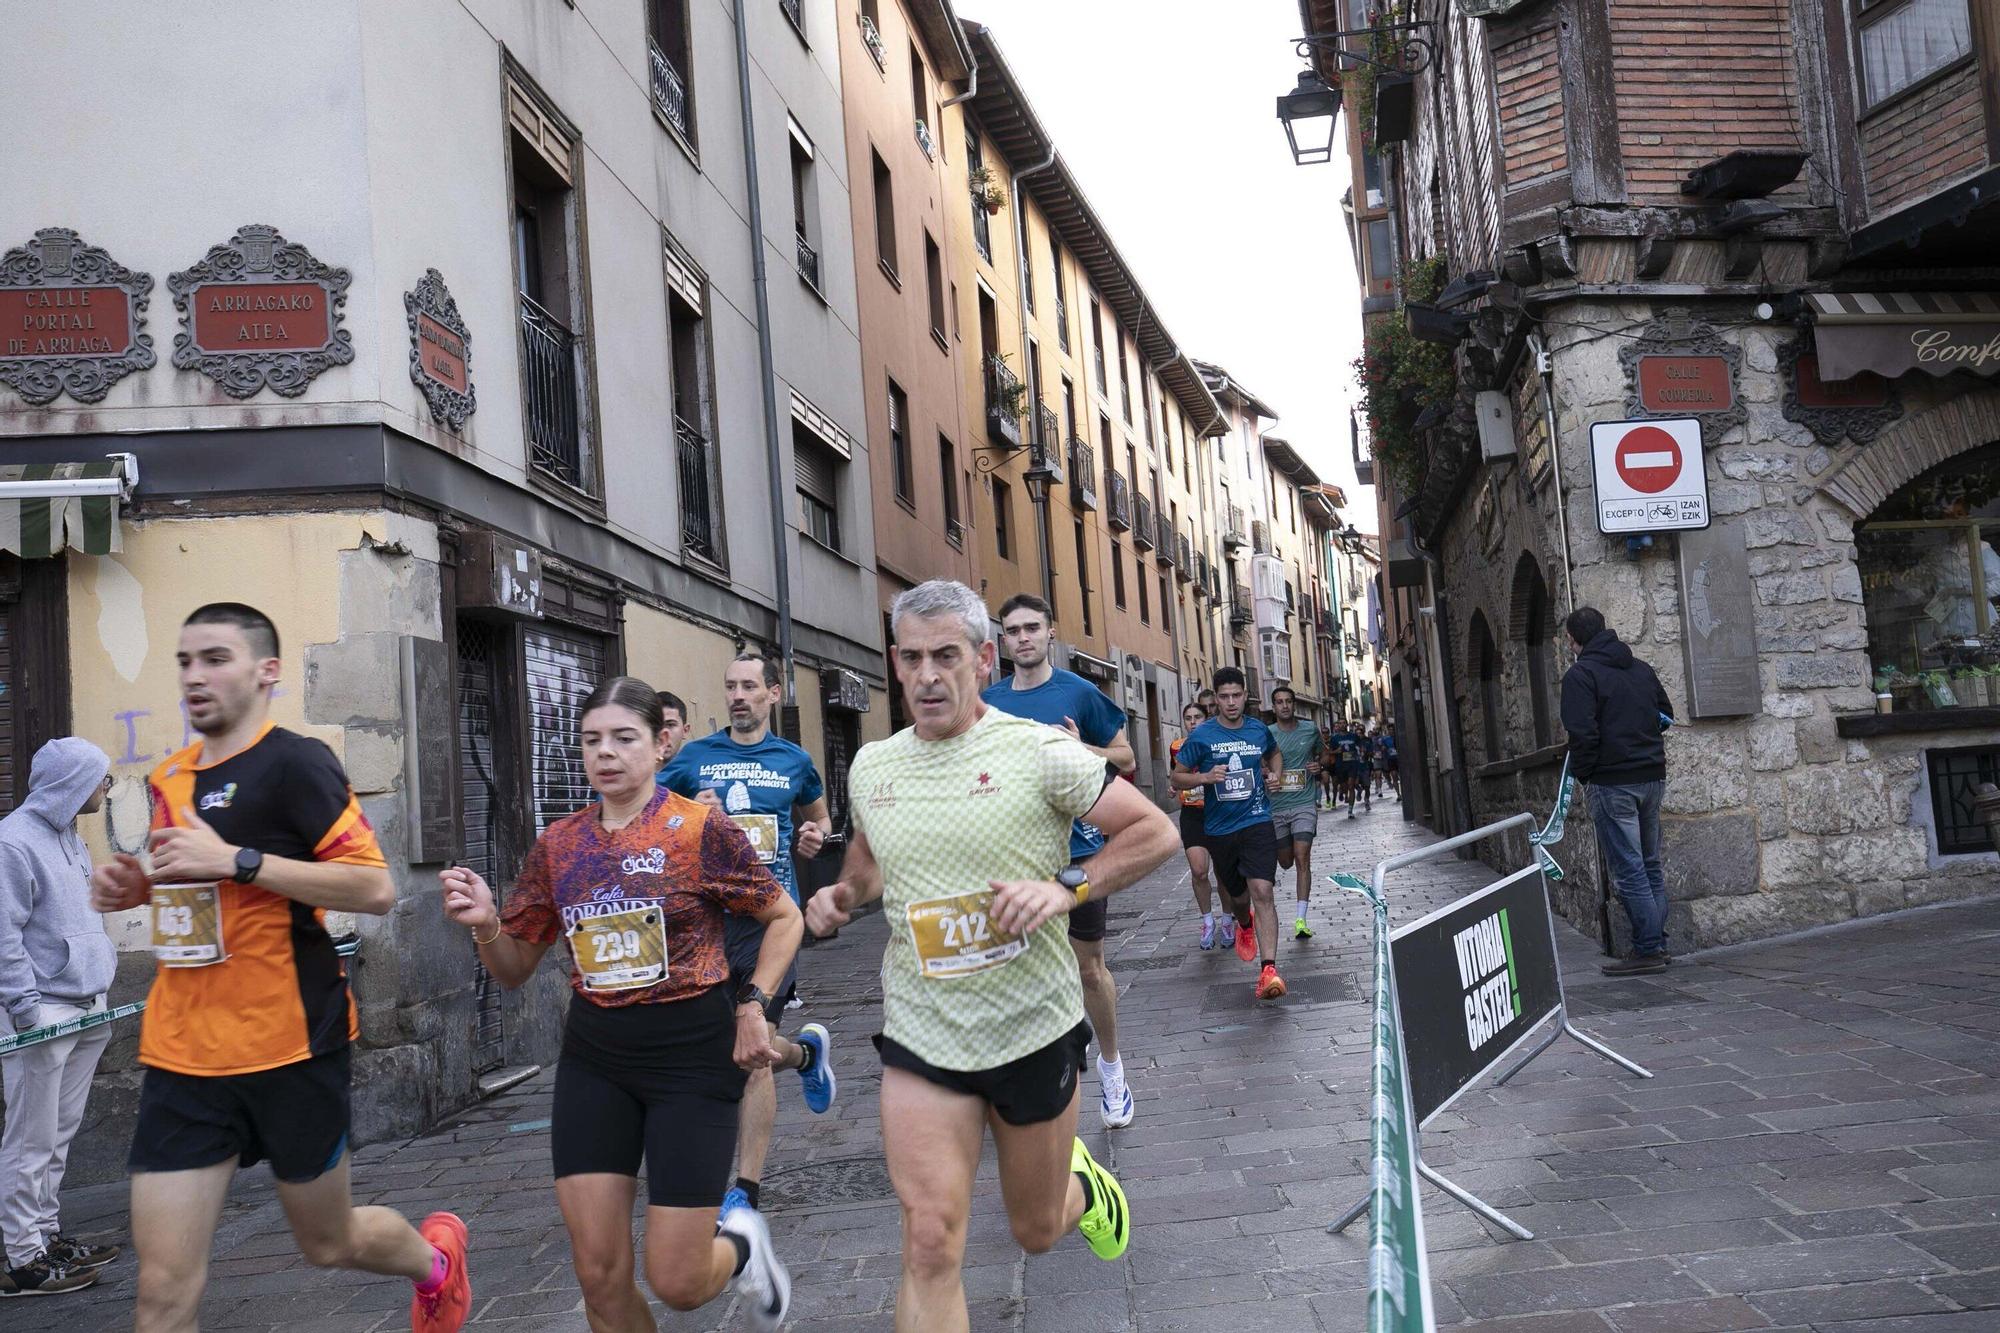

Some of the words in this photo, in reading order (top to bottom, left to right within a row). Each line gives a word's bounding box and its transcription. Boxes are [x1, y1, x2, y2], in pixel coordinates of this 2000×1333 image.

[25, 290, 91, 308] CALLE
[210, 294, 313, 312] ARRIAGAKO
[23, 313, 96, 331] PORTAL
[239, 323, 288, 340] ATEA
[9, 338, 29, 355] DE
[35, 336, 113, 354] ARRIAGA
[1665, 364, 1702, 380] CALLE
[1605, 508, 1645, 519] EXCEPTO
[1680, 500, 1701, 510] IZAN
[1682, 511, 1701, 521] EZIK
[700, 764, 710, 772] LA
[711, 762, 762, 772] CONQUISTA
[711, 769, 779, 781] ALMENDRA
[747, 779, 791, 790] KONKISTA
[1224, 777, 1246, 791] 892
[591, 884, 625, 902] Cafés
[938, 911, 991, 948] 212
[591, 929, 641, 963] 239
[1453, 912, 1508, 991] VITORIA
[1464, 968, 1515, 1052] GASTEIZ
